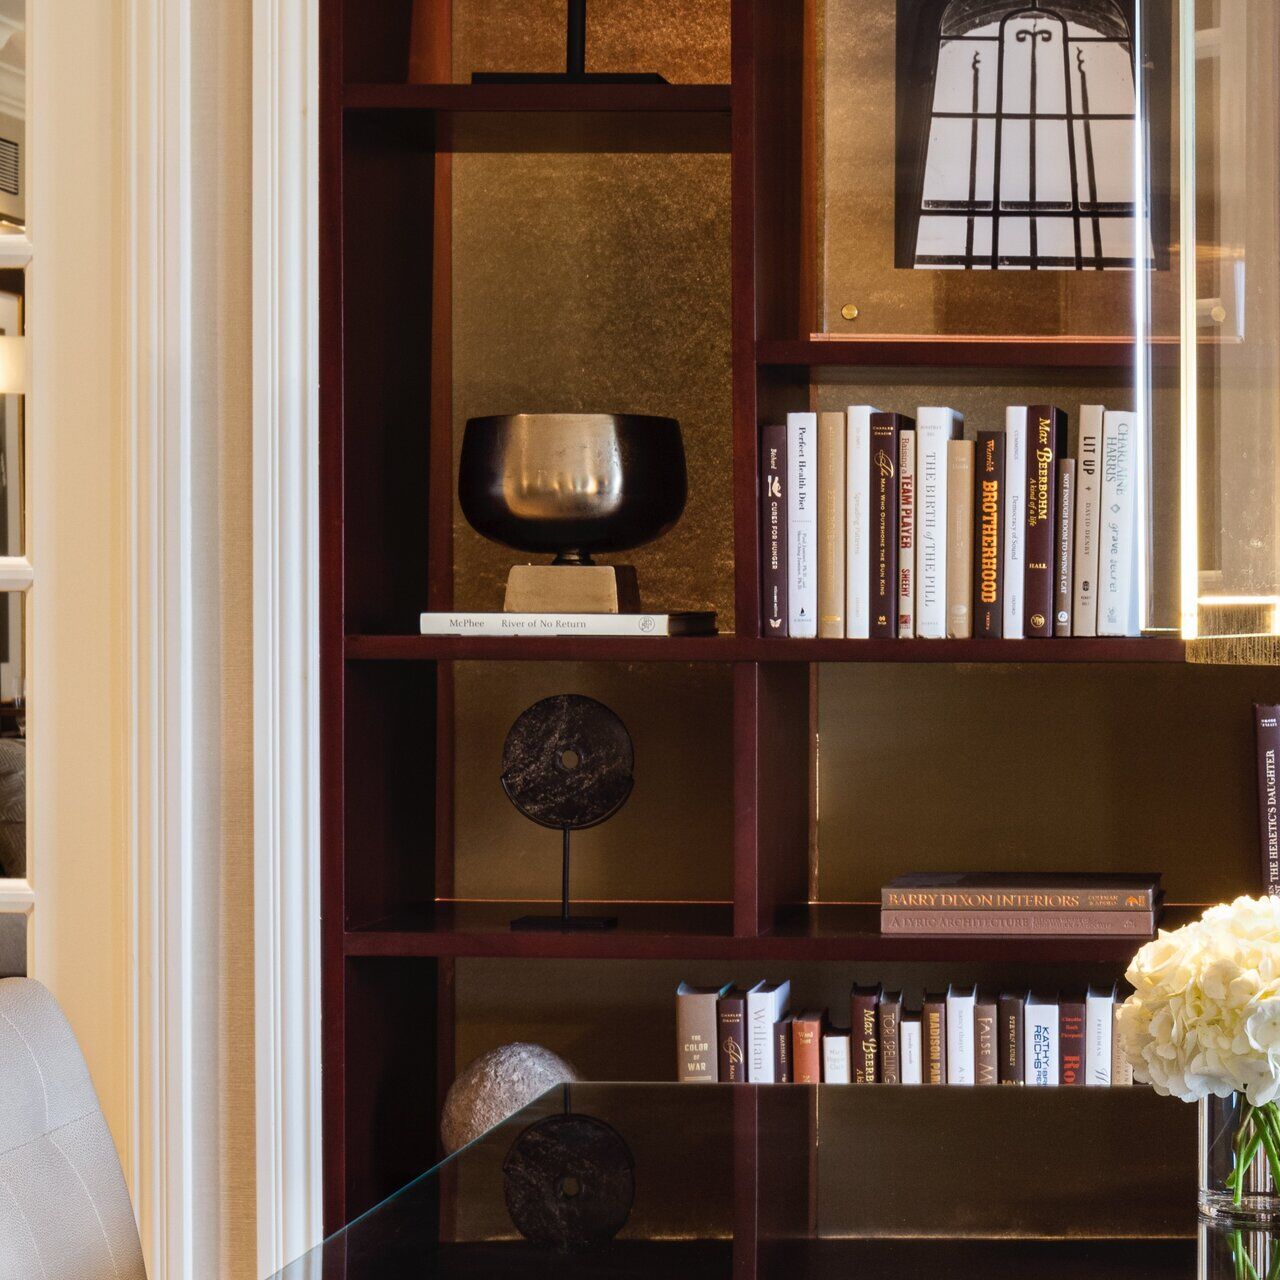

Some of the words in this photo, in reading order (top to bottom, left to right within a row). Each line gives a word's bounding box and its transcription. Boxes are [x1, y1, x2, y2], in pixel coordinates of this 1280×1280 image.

[798, 426, 807, 457] Perfect
[1037, 417, 1051, 444] Max
[1082, 436, 1096, 453] LIT
[901, 437, 910, 468] Raising
[925, 451, 937, 481] THE
[1082, 459, 1096, 476] UP
[1105, 436, 1117, 483] HARRIS
[1115, 422, 1129, 496] CHARLAINE
[798, 459, 807, 490] Health
[1035, 447, 1053, 520] BEERBOHM
[1062, 473, 1070, 488] NOT
[798, 491, 807, 511] Diet
[902, 474, 913, 506] TEAM
[1028, 484, 1037, 500] kind
[1061, 488, 1069, 518] ENOUGH
[770, 500, 778, 524] CURES
[925, 484, 937, 528] BIRTH
[1010, 495, 1019, 530] Democracy
[1028, 501, 1037, 510] of
[770, 524, 778, 540] FOR
[902, 508, 913, 549] PLAYER
[924, 531, 937, 542] of
[1010, 531, 1019, 539] of
[1028, 516, 1037, 527] life
[1061, 518, 1069, 541] ROOM
[981, 479, 998, 603] BROTHERHOOD
[1010, 539, 1019, 561] Sound
[1060, 541, 1069, 551] TO
[1107, 523, 1120, 554] grave
[770, 540, 778, 570] HUNGER
[925, 542, 937, 572] THE
[1060, 551, 1069, 575] SWING
[1060, 580, 1068, 595] CAT
[1108, 559, 1119, 593] secret
[925, 575, 937, 608] PILL
[449, 619, 485, 628] McPhee
[501, 619, 525, 628] River
[527, 619, 537, 628] of
[539, 619, 553, 628] No
[555, 619, 587, 628] Return
[1264, 749, 1276, 806] DAUGHTER
[1267, 807, 1278, 861] HERETIC'S
[1270, 862, 1280, 883] THE
[888, 893, 939, 907] BARRY
[940, 893, 993, 907] DIXON
[996, 894, 1080, 908] INTERIORS
[753, 1008, 767, 1071] William
[883, 1012, 896, 1037] TORI
[977, 1016, 994, 1056] FALSE
[684, 1042, 709, 1052] COLOR
[779, 1034, 787, 1065] MARSHALL
[883, 1040, 897, 1084] SPELLING
[1033, 1024, 1042, 1070] REICHS
[1042, 1026, 1050, 1068] KATHY
[687, 1062, 706, 1072] WAR
